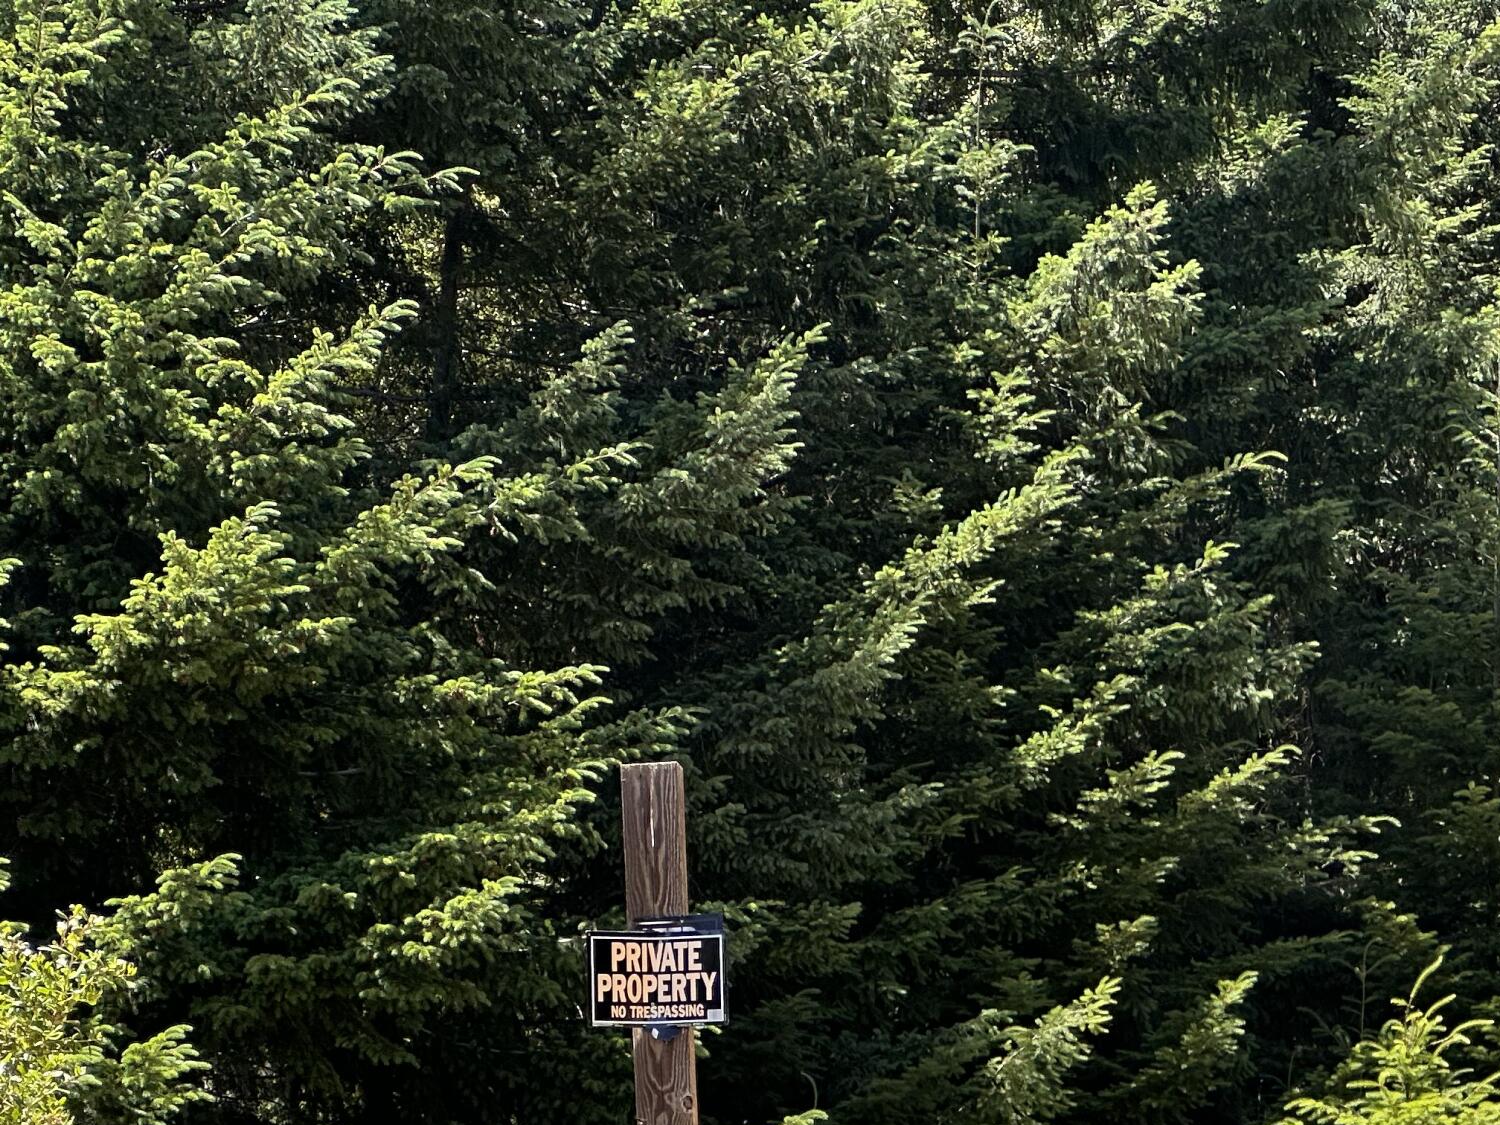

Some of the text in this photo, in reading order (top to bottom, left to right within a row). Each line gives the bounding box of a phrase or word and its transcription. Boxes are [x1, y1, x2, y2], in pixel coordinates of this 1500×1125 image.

[611, 941, 702, 972] PRIVATE
[597, 972, 717, 1003] PROPERTY
[611, 1004, 704, 1018] NO TRESPASSING
